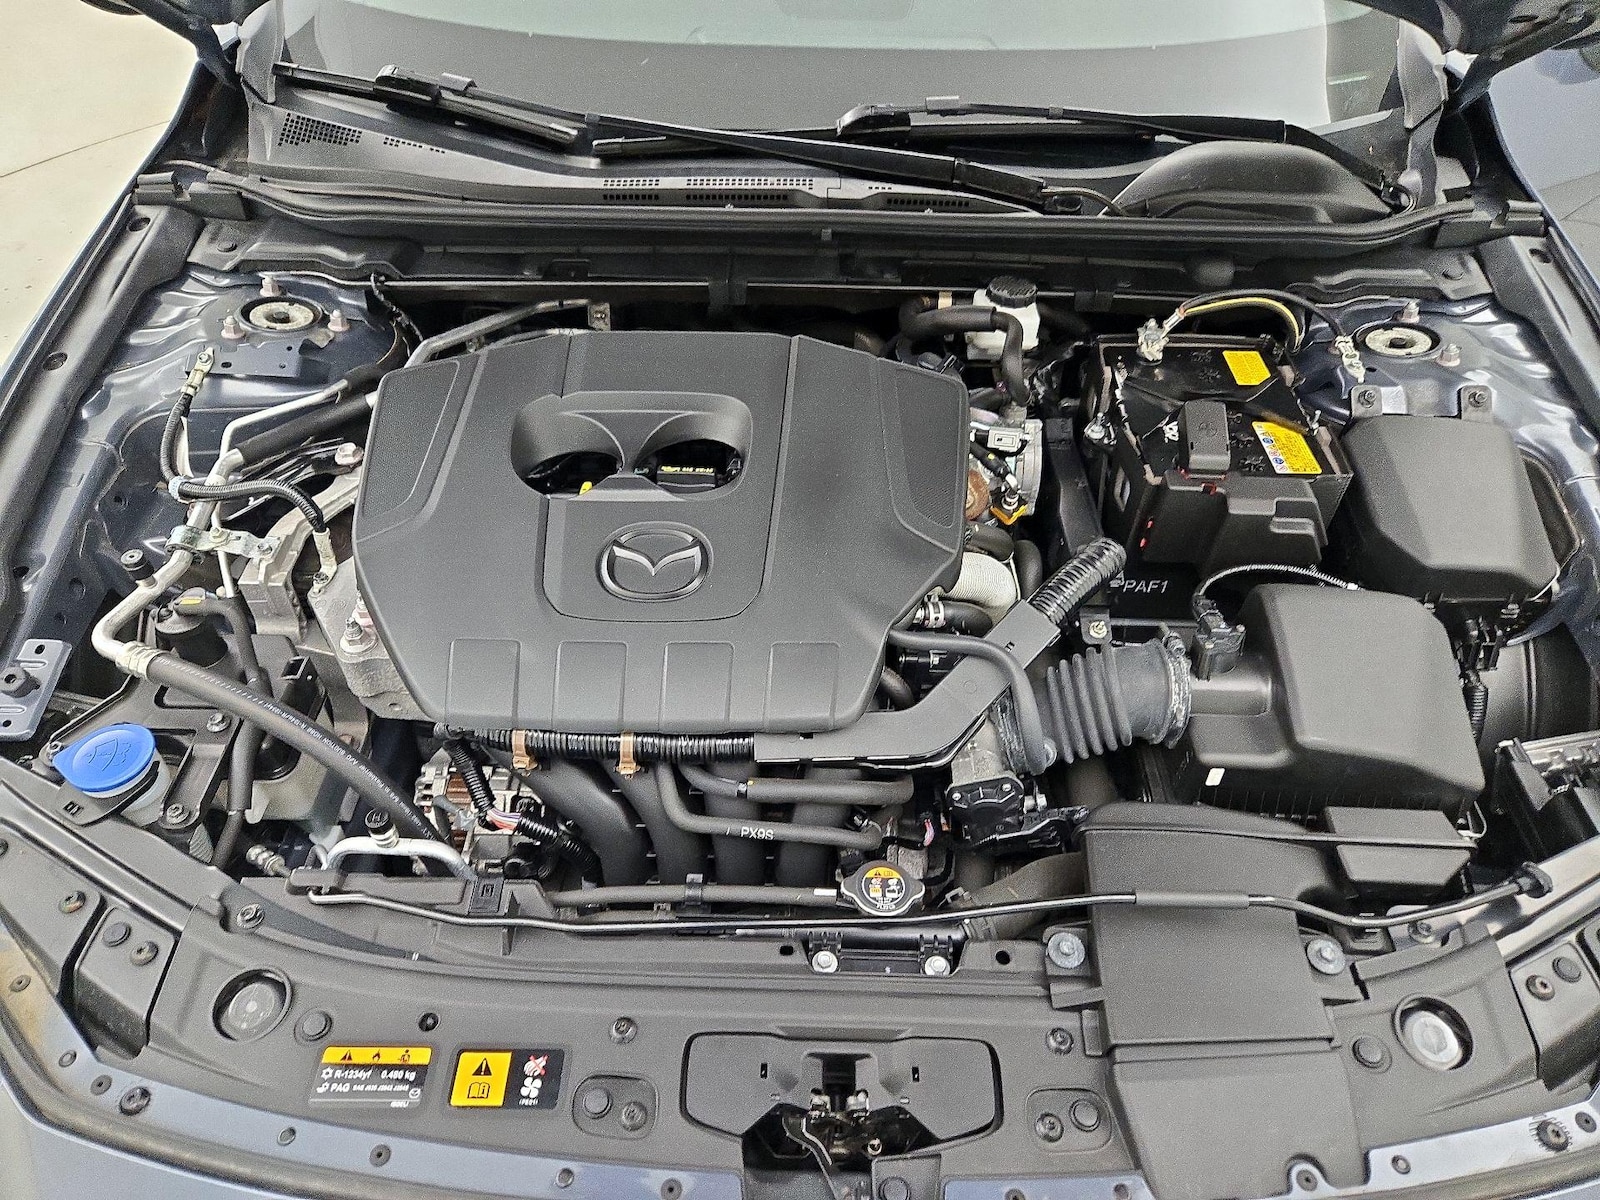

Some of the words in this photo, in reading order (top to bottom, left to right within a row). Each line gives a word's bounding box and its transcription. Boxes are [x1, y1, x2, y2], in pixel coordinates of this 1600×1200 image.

[1122, 579, 1169, 594] PAF1
[740, 826, 774, 841] PX9S
[404, 1070, 417, 1082] kg
[329, 1082, 351, 1092] PAG
